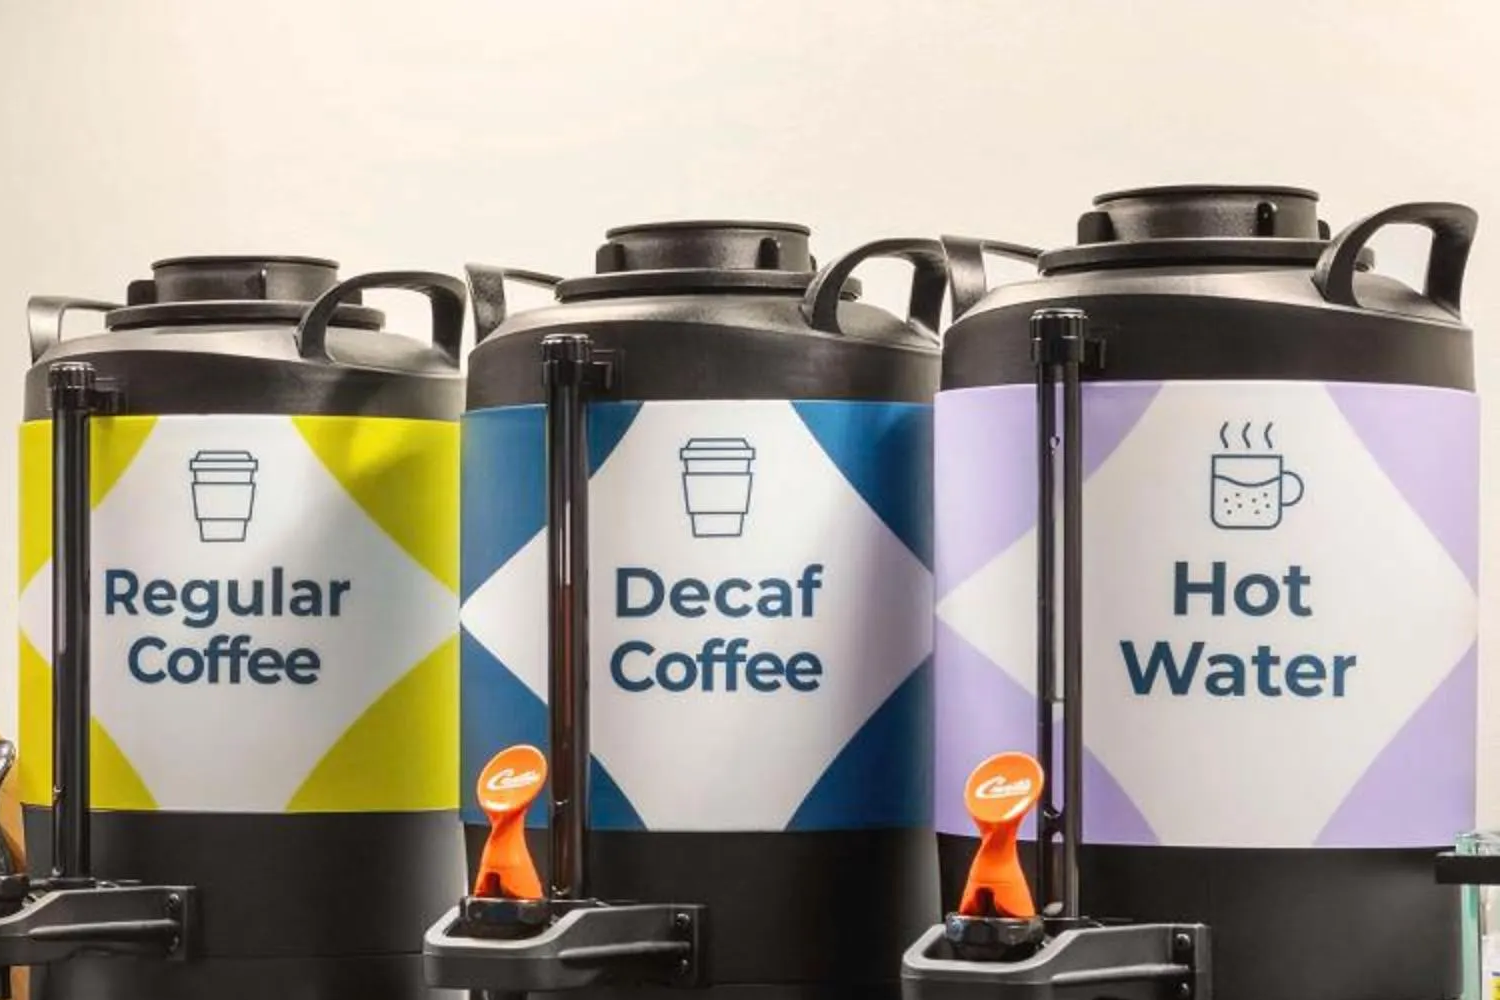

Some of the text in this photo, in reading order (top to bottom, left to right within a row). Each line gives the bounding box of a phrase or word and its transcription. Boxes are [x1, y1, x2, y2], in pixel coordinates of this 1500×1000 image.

[104, 566, 351, 628] Regular
[615, 563, 824, 620] Decaf
[1172, 560, 1313, 617] Hot
[127, 633, 322, 686] Coffee
[609, 638, 824, 693] Coffee
[1118, 639, 1357, 698] Water
